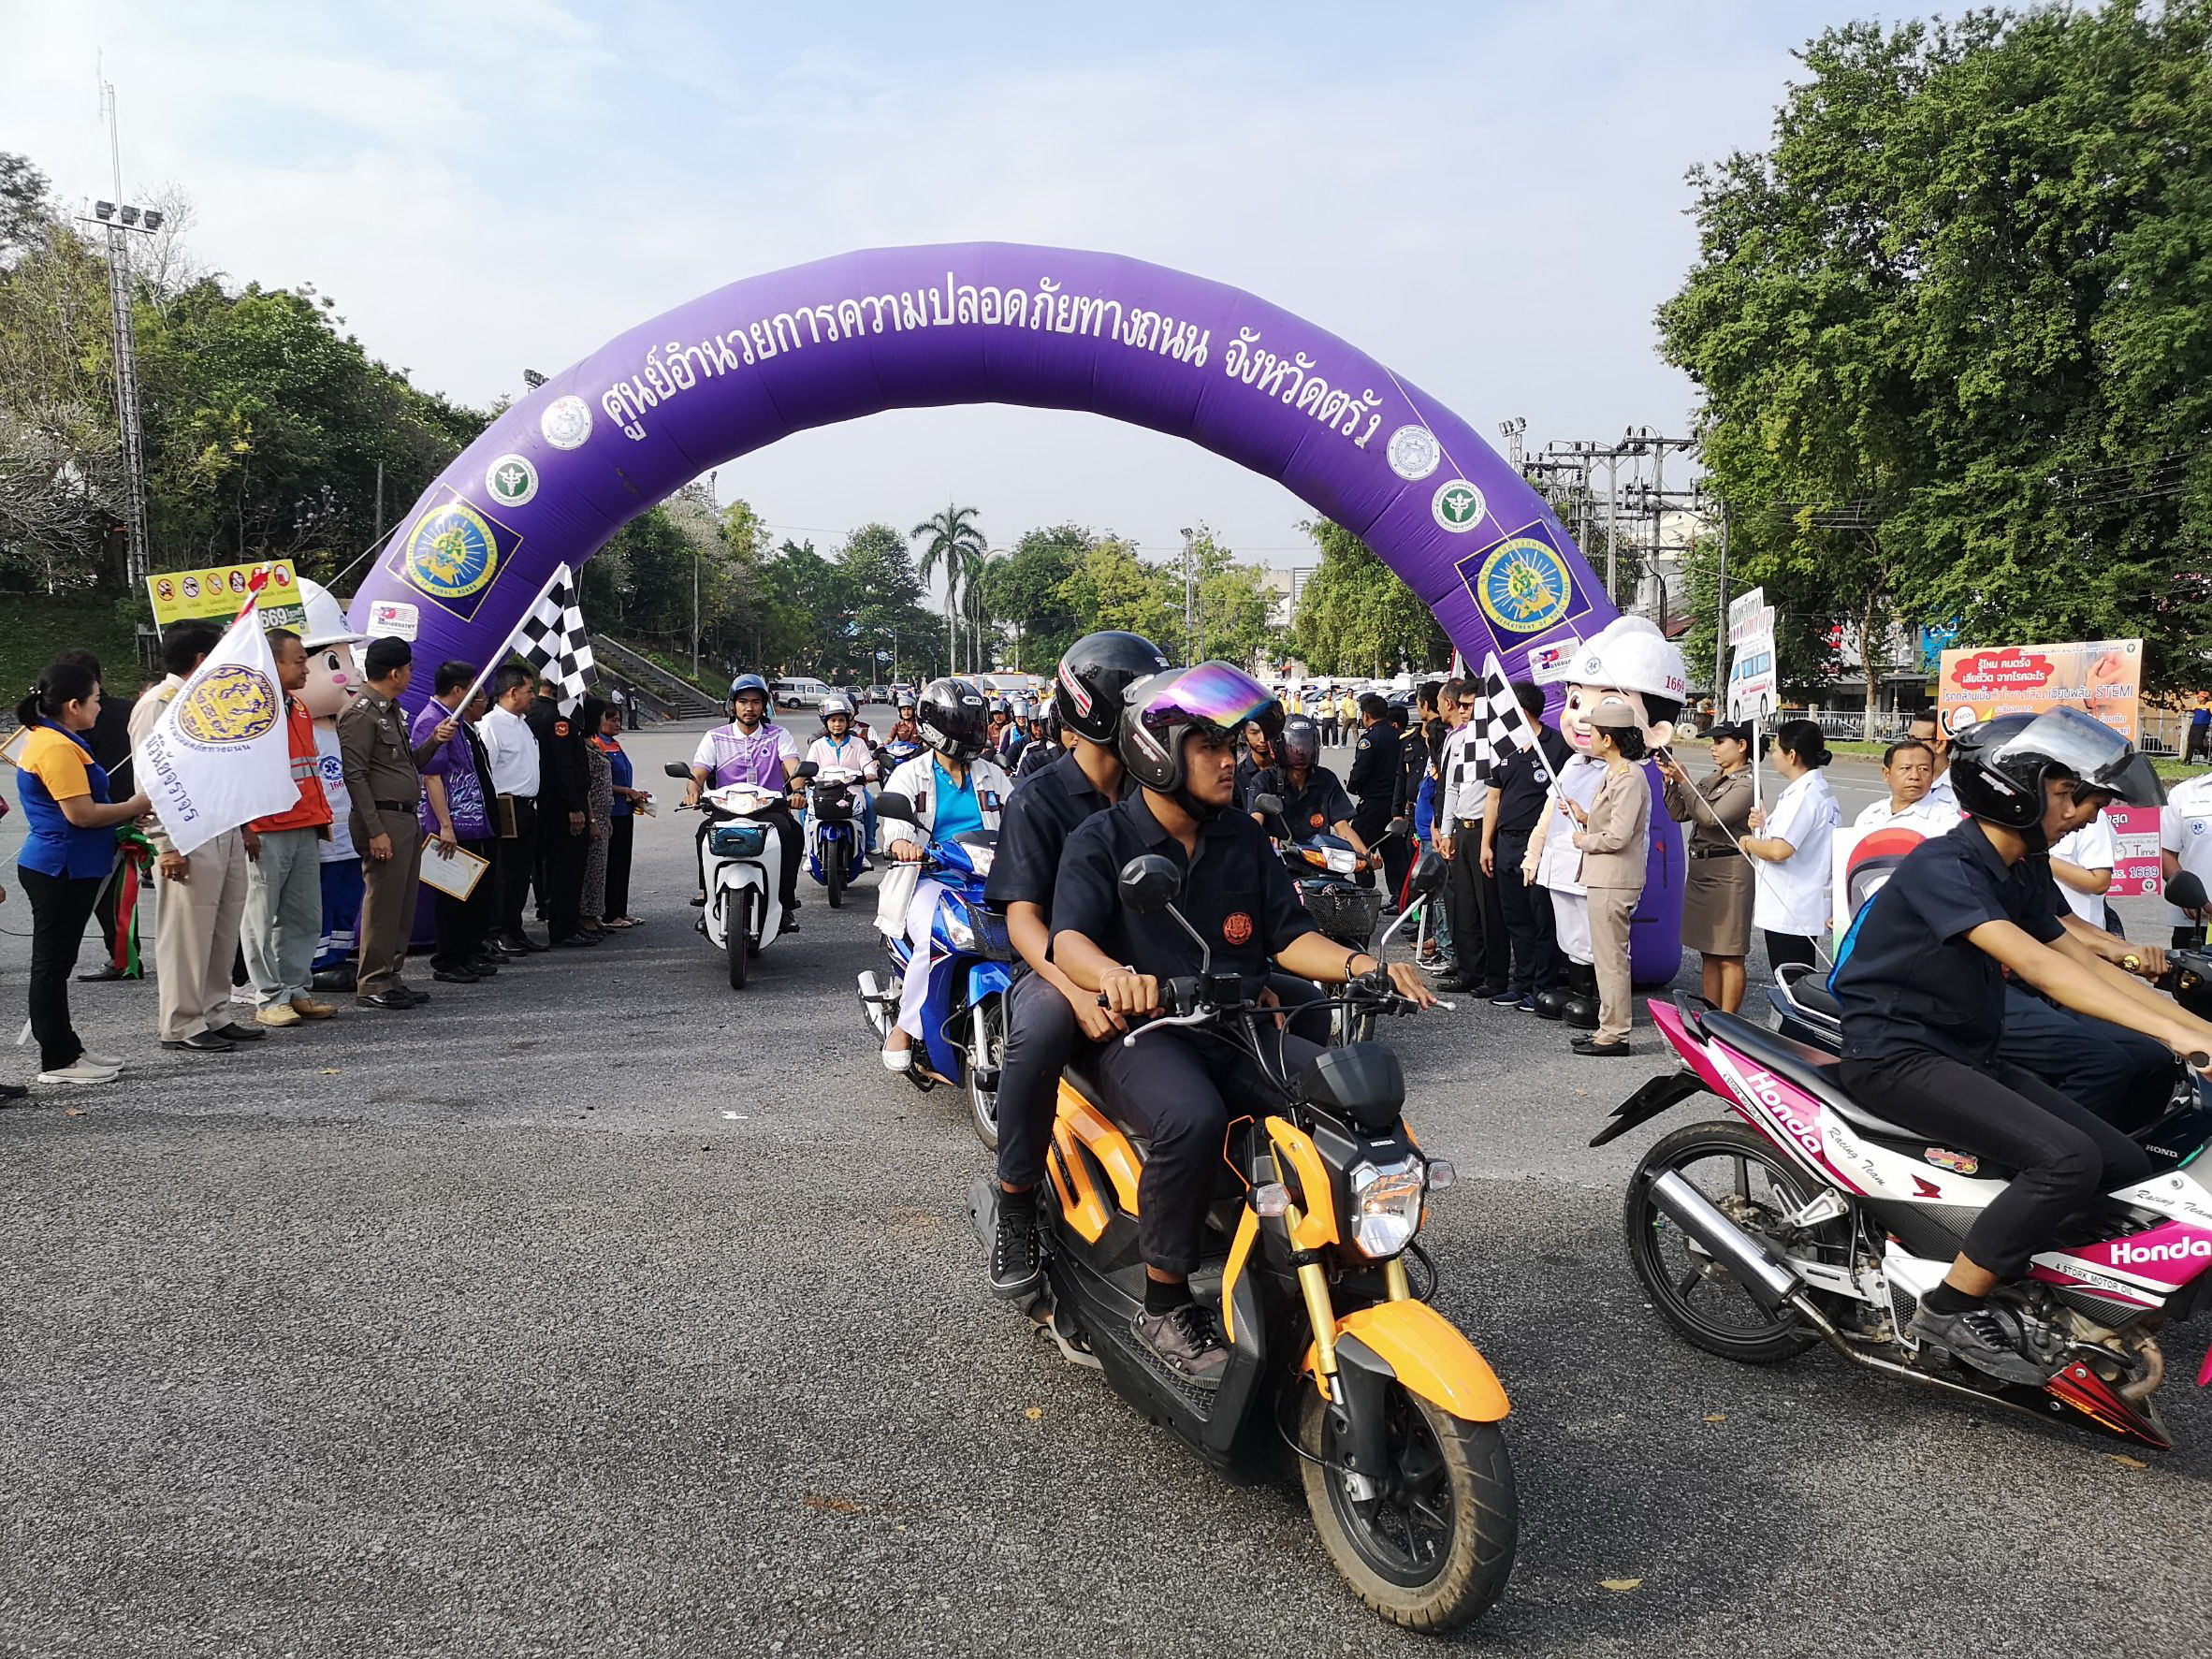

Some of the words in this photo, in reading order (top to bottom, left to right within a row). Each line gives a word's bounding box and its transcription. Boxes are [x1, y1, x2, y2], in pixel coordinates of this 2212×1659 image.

[601, 270, 1211, 442] ศูนย์อำนวยการความปลอดภัยทางถนน
[1224, 326, 1383, 449] จังหวัดตรัง
[259, 607, 287, 628] 669
[2096, 684, 2133, 698] STEMI
[329, 779, 344, 791] 166
[2132, 844, 2156, 856] Time
[2130, 866, 2159, 879] 1669
[1745, 1071, 1823, 1155] Honda
[1827, 1126, 1858, 1159] Racing
[1861, 1159, 1886, 1187] Team
[2145, 1143, 2179, 1158] HOND
[2134, 1189, 2176, 1206] Racing
[2183, 1201, 2212, 1220] Team
[2109, 1236, 2212, 1265] Honda
[2062, 1264, 2088, 1279] STORK
[2089, 1274, 2119, 1290] MOTOR
[2120, 1285, 2134, 1296] OIL
